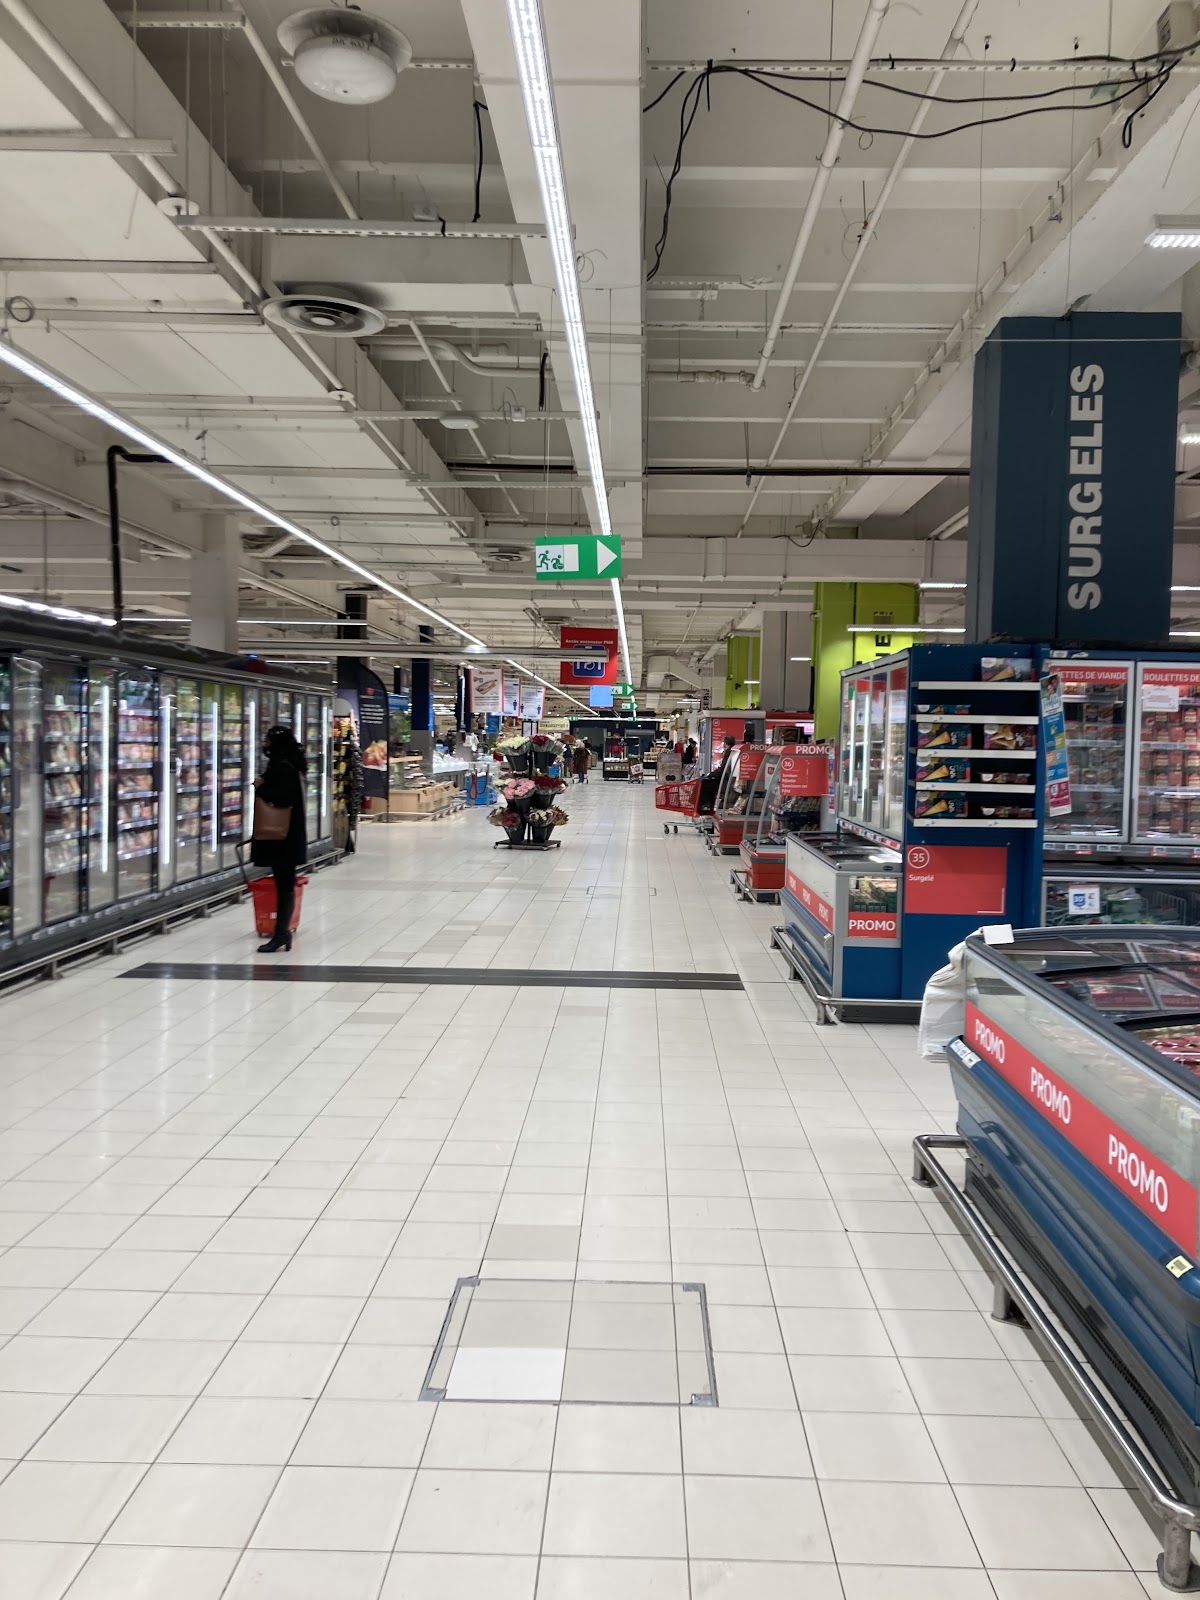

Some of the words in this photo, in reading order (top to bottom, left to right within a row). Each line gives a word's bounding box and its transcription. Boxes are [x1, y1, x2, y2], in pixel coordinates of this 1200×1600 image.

[1068, 364, 1104, 610] SURGELES
[1085, 671, 1096, 680] DE
[1097, 672, 1127, 680] VIANDE
[1144, 673, 1189, 682] BOULETTES
[1190, 674, 1200, 683] DE
[912, 853, 925, 863] 35
[909, 874, 935, 882] Surgelé
[849, 920, 896, 932] PROMO
[975, 1019, 1006, 1063] PROMO
[1030, 1067, 1072, 1124] PROMO
[1108, 1134, 1168, 1212] PROMO
